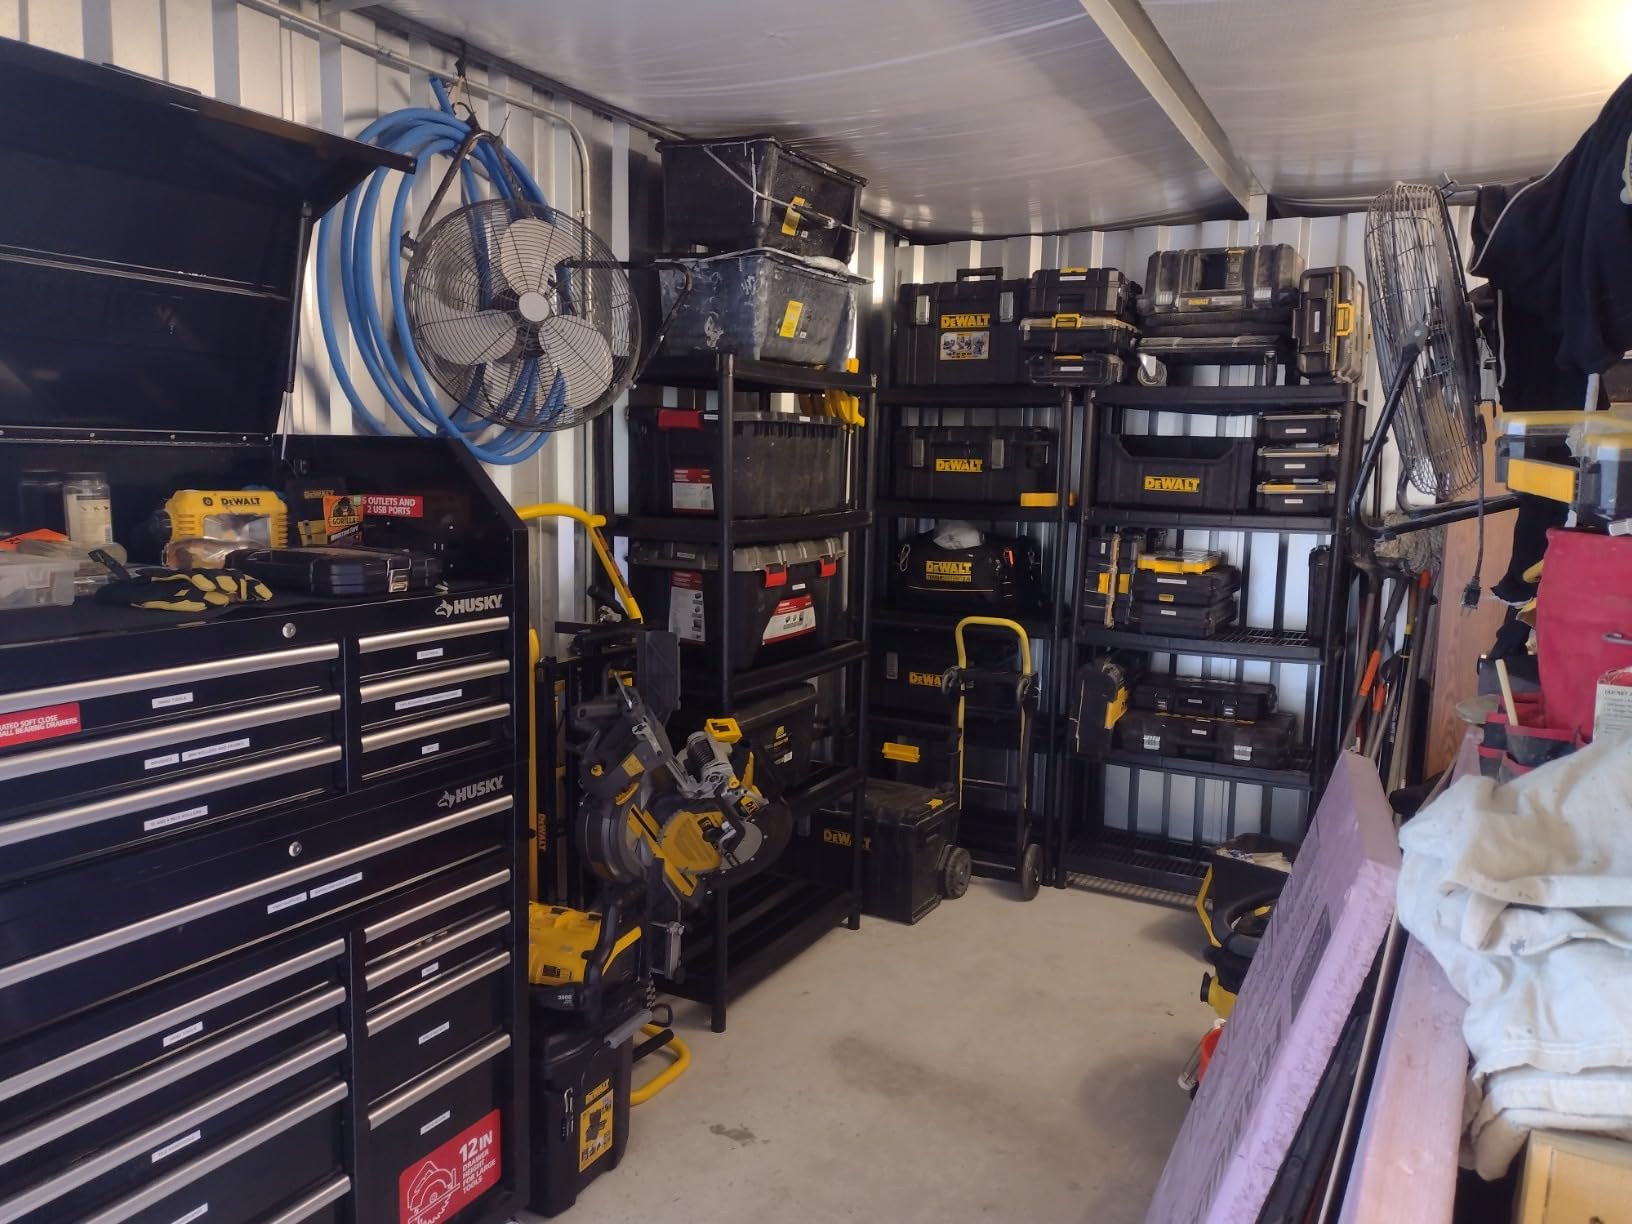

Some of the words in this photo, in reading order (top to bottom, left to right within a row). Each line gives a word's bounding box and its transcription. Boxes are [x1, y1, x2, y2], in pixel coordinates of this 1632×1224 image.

[941, 314, 991, 328] DEWALT
[936, 459, 983, 472] DEWALT
[1144, 476, 1200, 492] DEWALT
[221, 497, 260, 505] DEWALT
[367, 496, 398, 506] OUTLETS
[399, 498, 416, 507] AND
[367, 505, 372, 513] 2
[373, 506, 387, 514] USB
[388, 506, 411, 515] PORTS
[332, 517, 356, 525] GORILLA
[926, 561, 972, 574] DEWALT
[454, 593, 503, 615] HUSKY
[909, 672, 943, 688] DEWA
[15, 723, 45, 734] BEARING
[46, 717, 78, 729] DRAWERS
[20, 718, 37, 727] SOFT
[37, 714, 58, 724] CLOSE
[455, 775, 504, 804] HUSKY
[824, 829, 871, 849] DEWT
[459, 1138, 478, 1163] 12
[480, 1130, 493, 1151] IN
[463, 1149, 489, 1171] DRAWER
[463, 1159, 484, 1179] HEIGHT
[463, 1174, 476, 1187] FOR
[476, 1158, 496, 1177] LARGE
[463, 1176, 483, 1194] TOOLS
